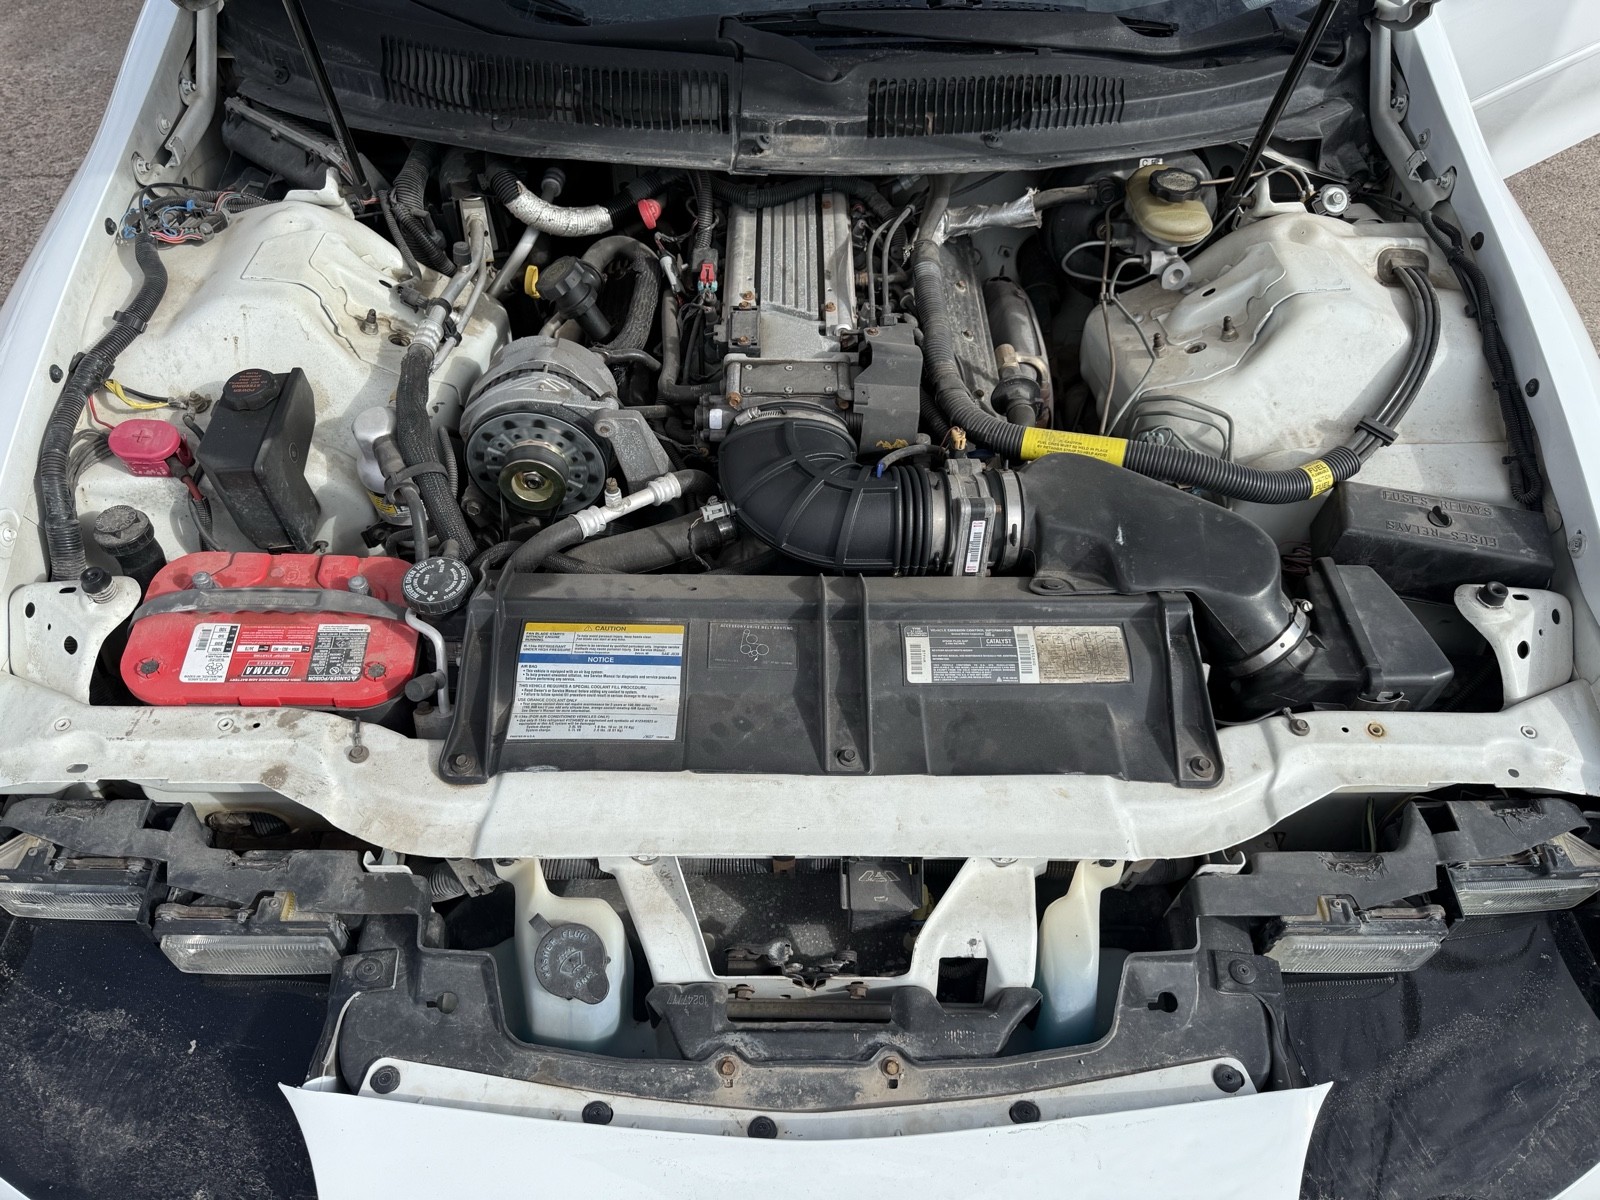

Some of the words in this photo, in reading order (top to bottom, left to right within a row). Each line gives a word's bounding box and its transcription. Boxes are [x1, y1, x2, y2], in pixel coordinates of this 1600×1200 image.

[1307, 464, 1326, 474] FUEL
[1315, 481, 1330, 491] FUEL
[1382, 490, 1428, 506] FUSES
[1440, 500, 1493, 516] RELAYS
[1386, 520, 1440, 537] RELAYS
[1451, 531, 1498, 547] FUSES
[415, 562, 428, 570] HOT
[406, 570, 416, 583] OPEN
[406, 586, 420, 598] NEVER
[246, 666, 290, 675] OPTIMA
[562, 930, 590, 942] FLUID
[575, 968, 599, 990] ONLY
